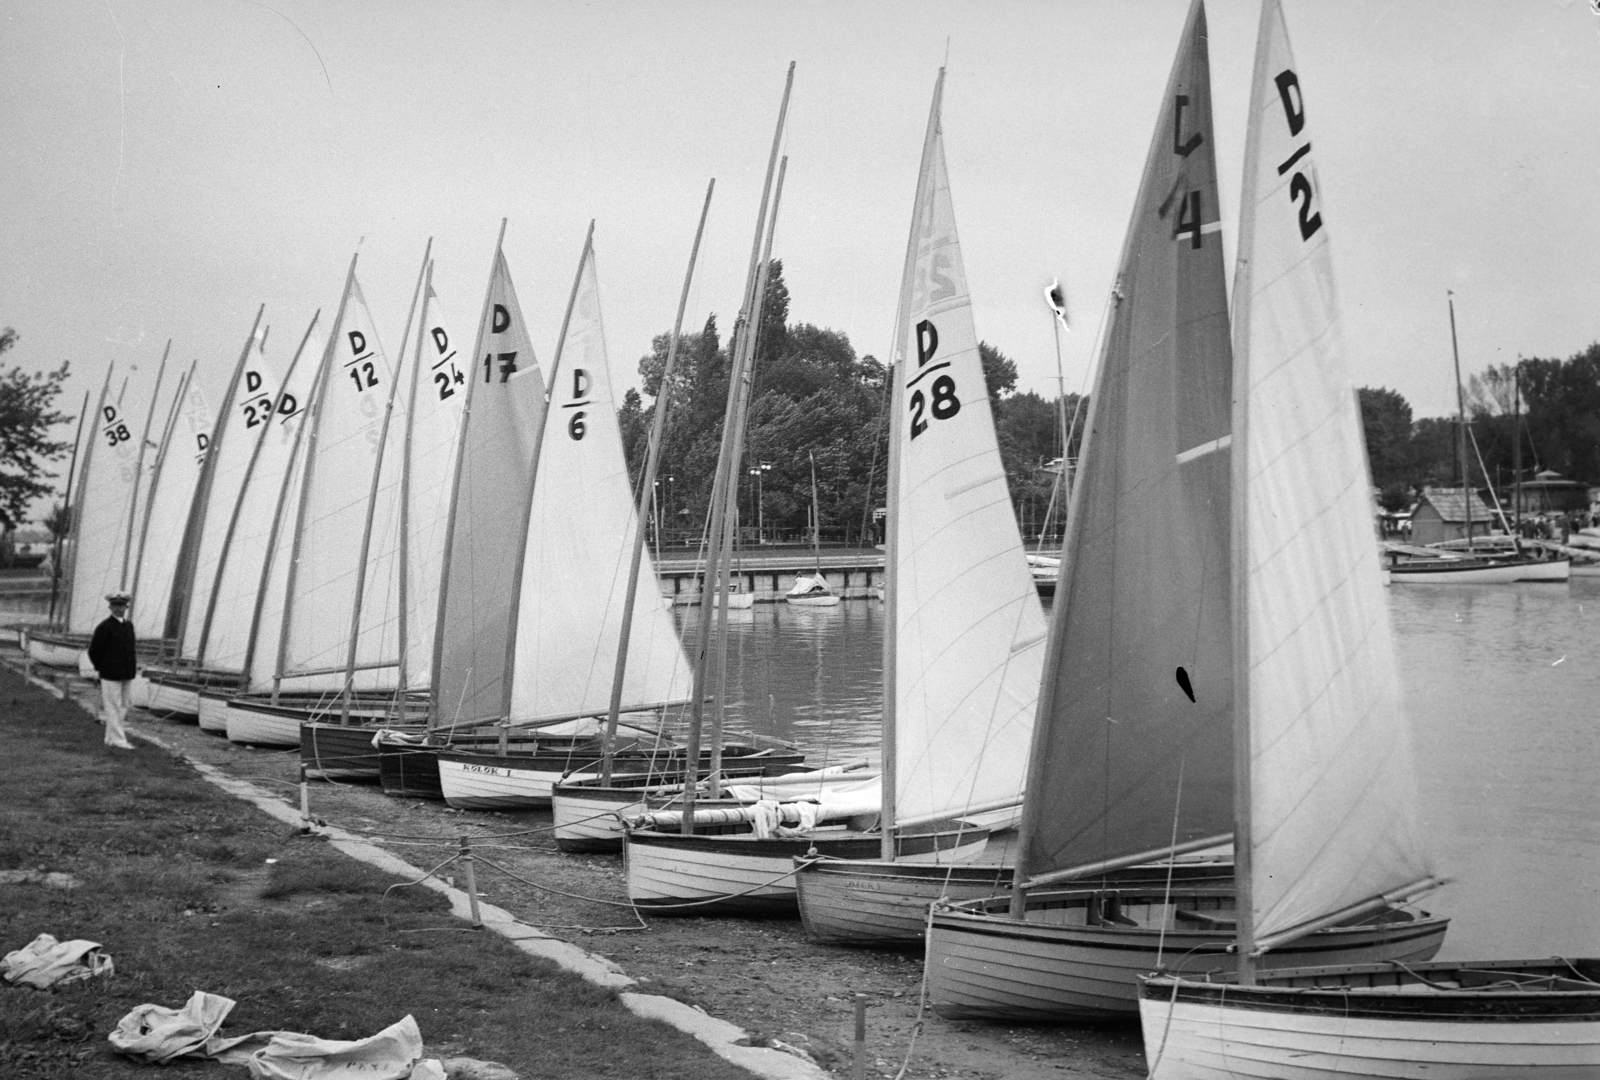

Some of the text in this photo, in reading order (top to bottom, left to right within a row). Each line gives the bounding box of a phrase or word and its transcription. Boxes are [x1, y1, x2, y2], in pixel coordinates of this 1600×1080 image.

[1274, 69, 1305, 137] D
[1172, 189, 1202, 250] 4
[1290, 172, 1322, 242] 2
[491, 304, 511, 334] D
[348, 330, 366, 355] D
[431, 327, 448, 355] D
[916, 319, 938, 368] D
[246, 371, 262, 393] D
[350, 361, 379, 392] 12
[434, 362, 464, 401] 24
[484, 351, 517, 383] 17
[574, 369, 593, 399] D
[103, 405, 116, 423] D
[244, 399, 272, 429] 23
[277, 393, 297, 415] D
[909, 374, 961, 442] 28
[105, 424, 131, 447] 38
[568, 411, 587, 441] 6
[197, 433, 209, 450] D
